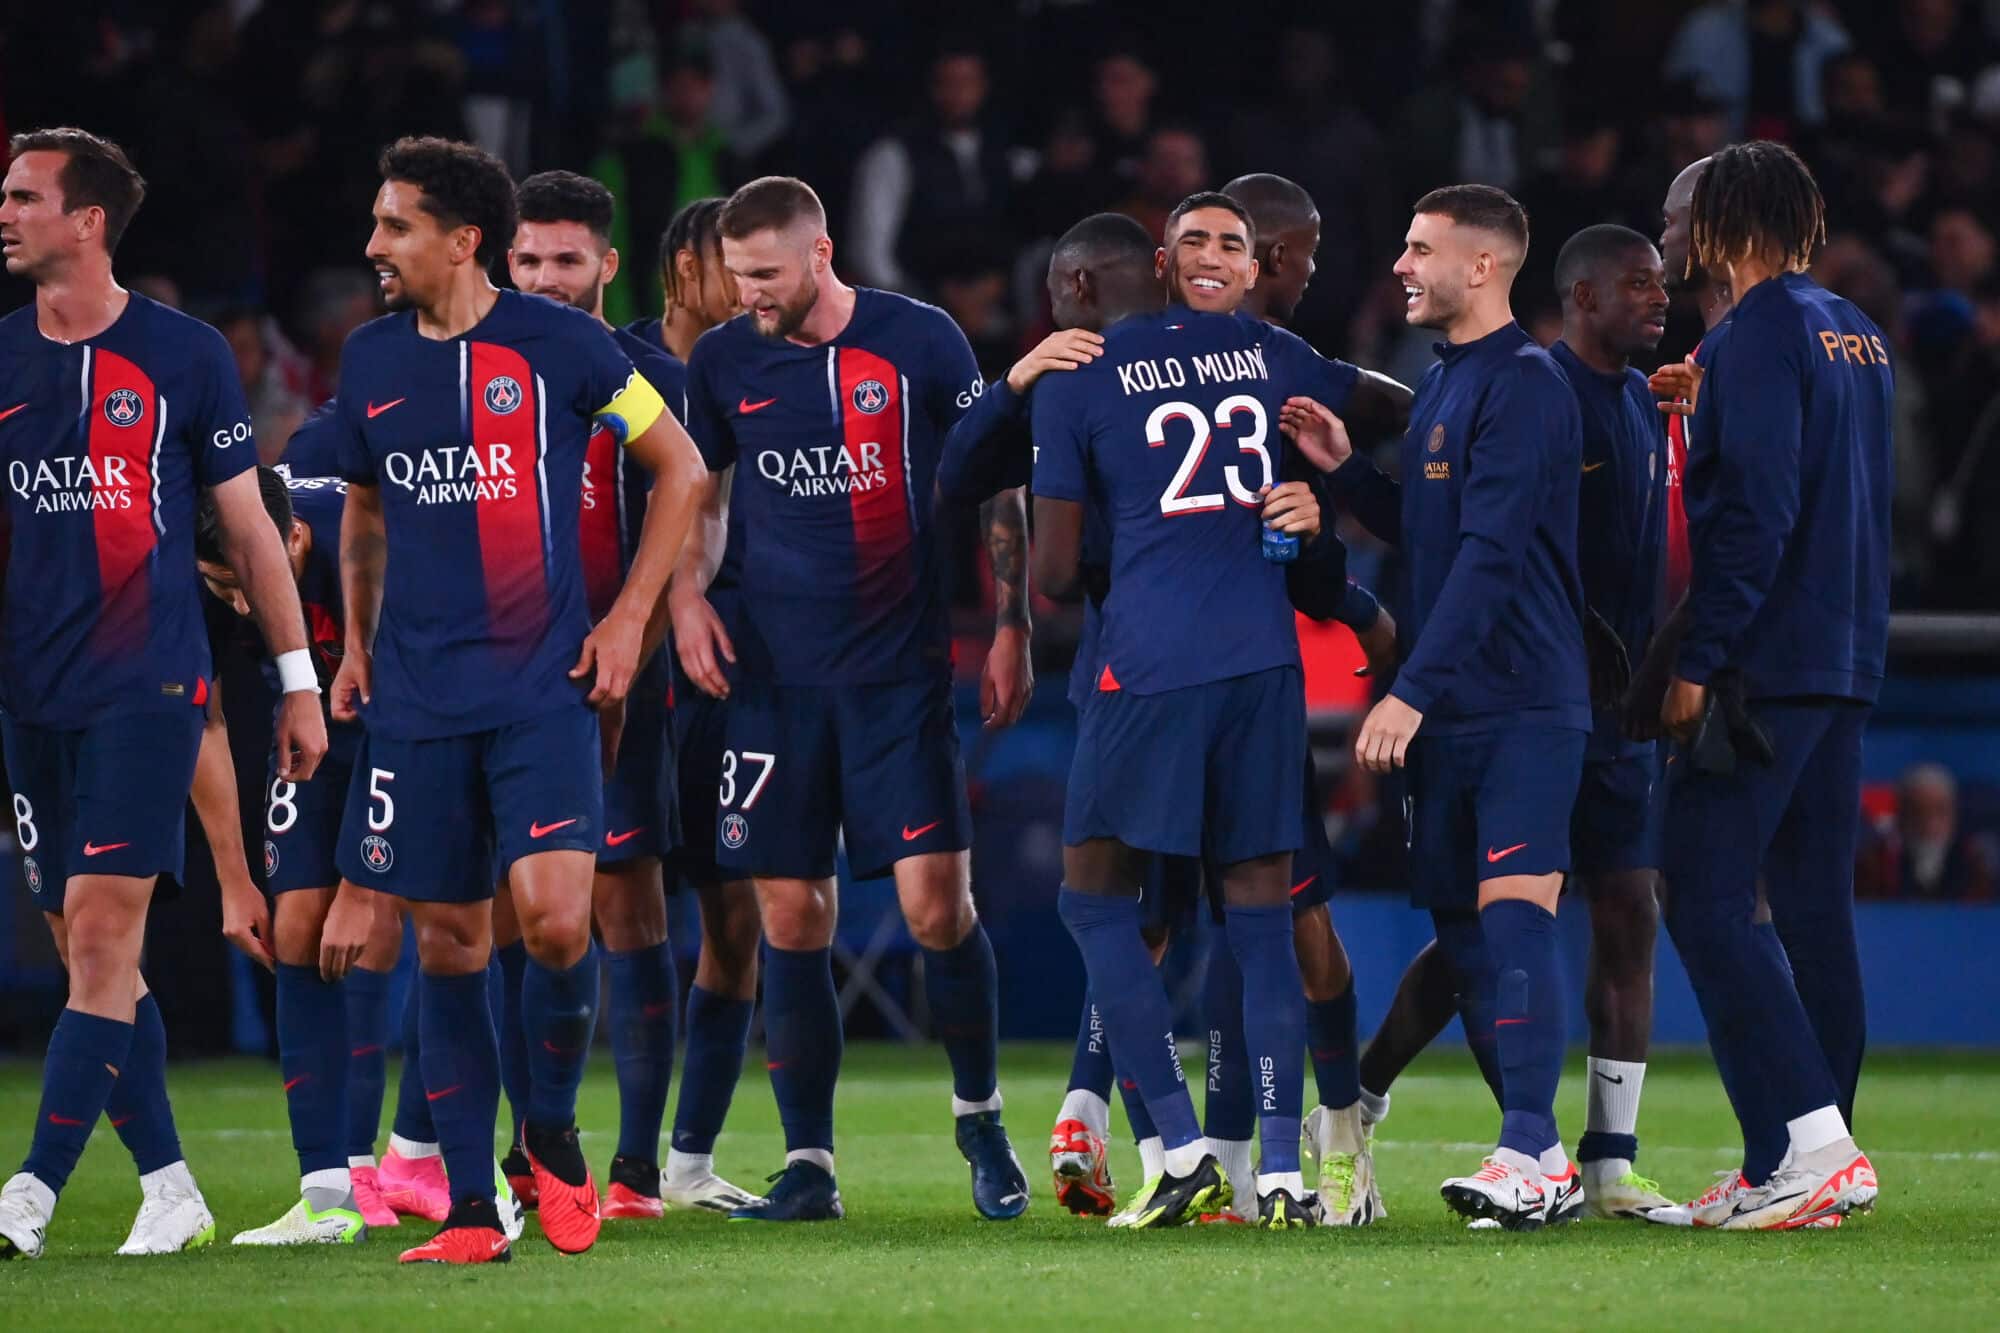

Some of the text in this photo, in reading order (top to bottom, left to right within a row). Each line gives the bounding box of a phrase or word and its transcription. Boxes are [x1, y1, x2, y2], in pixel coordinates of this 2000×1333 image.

[1117, 343, 1269, 395] KOLO MUANI
[111, 390, 137, 401] PARIS
[8, 455, 131, 501] QATAR
[385, 443, 517, 492] QATAR
[757, 441, 884, 486] QATAR
[1145, 394, 1273, 518] 23
[34, 488, 132, 515] AIRWAYS
[416, 477, 518, 505] AIRWAYS
[789, 469, 888, 498] AIRWAYS
[264, 775, 298, 834] 8
[368, 767, 396, 832] 5
[720, 749, 777, 811] 37
[13, 792, 38, 851] 8
[1164, 1031, 1186, 1083] PARIS
[1208, 1030, 1222, 1092] PARIS
[1259, 1056, 1277, 1110] PARIS
